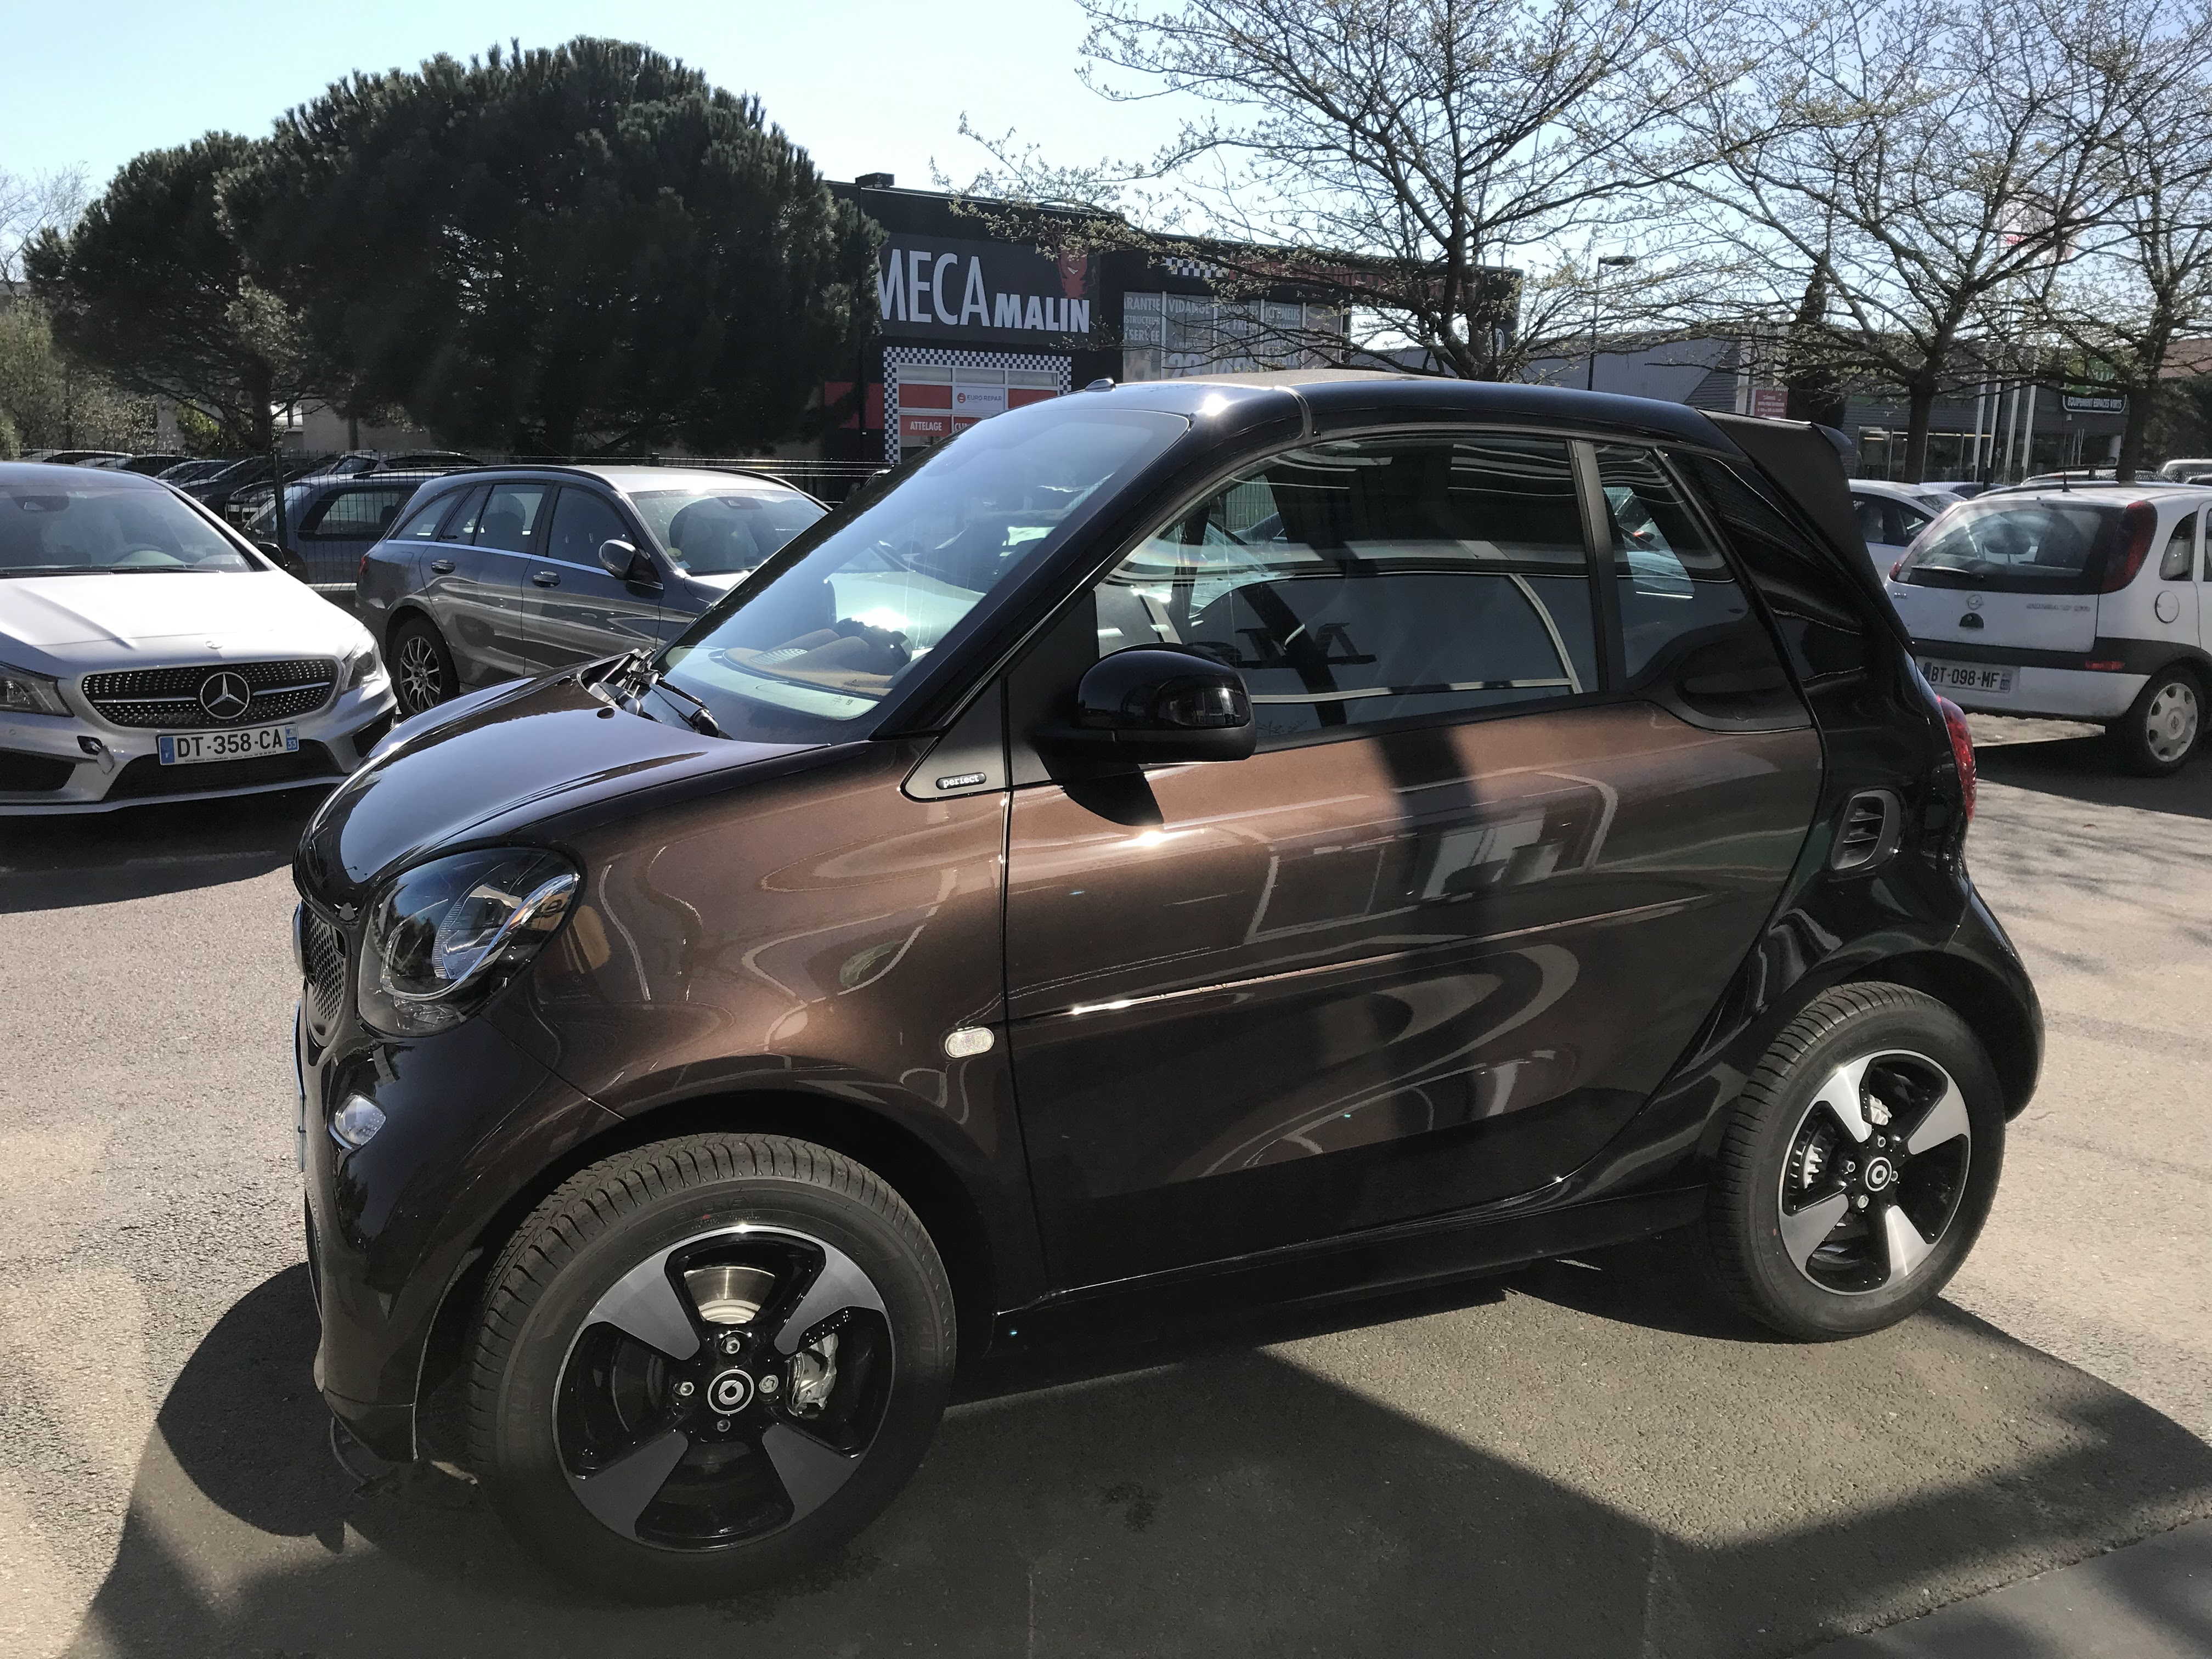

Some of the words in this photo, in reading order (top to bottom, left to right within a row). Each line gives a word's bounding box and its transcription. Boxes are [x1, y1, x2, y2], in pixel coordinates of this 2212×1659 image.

[877, 249, 990, 327] MECA
[994, 292, 1090, 334] MALIN
[910, 421, 943, 431] ATTELAGE
[1931, 665, 2000, 688] BT-098-MF
[177, 729, 283, 758] DT-358-CA
[943, 775, 979, 788] perfect
